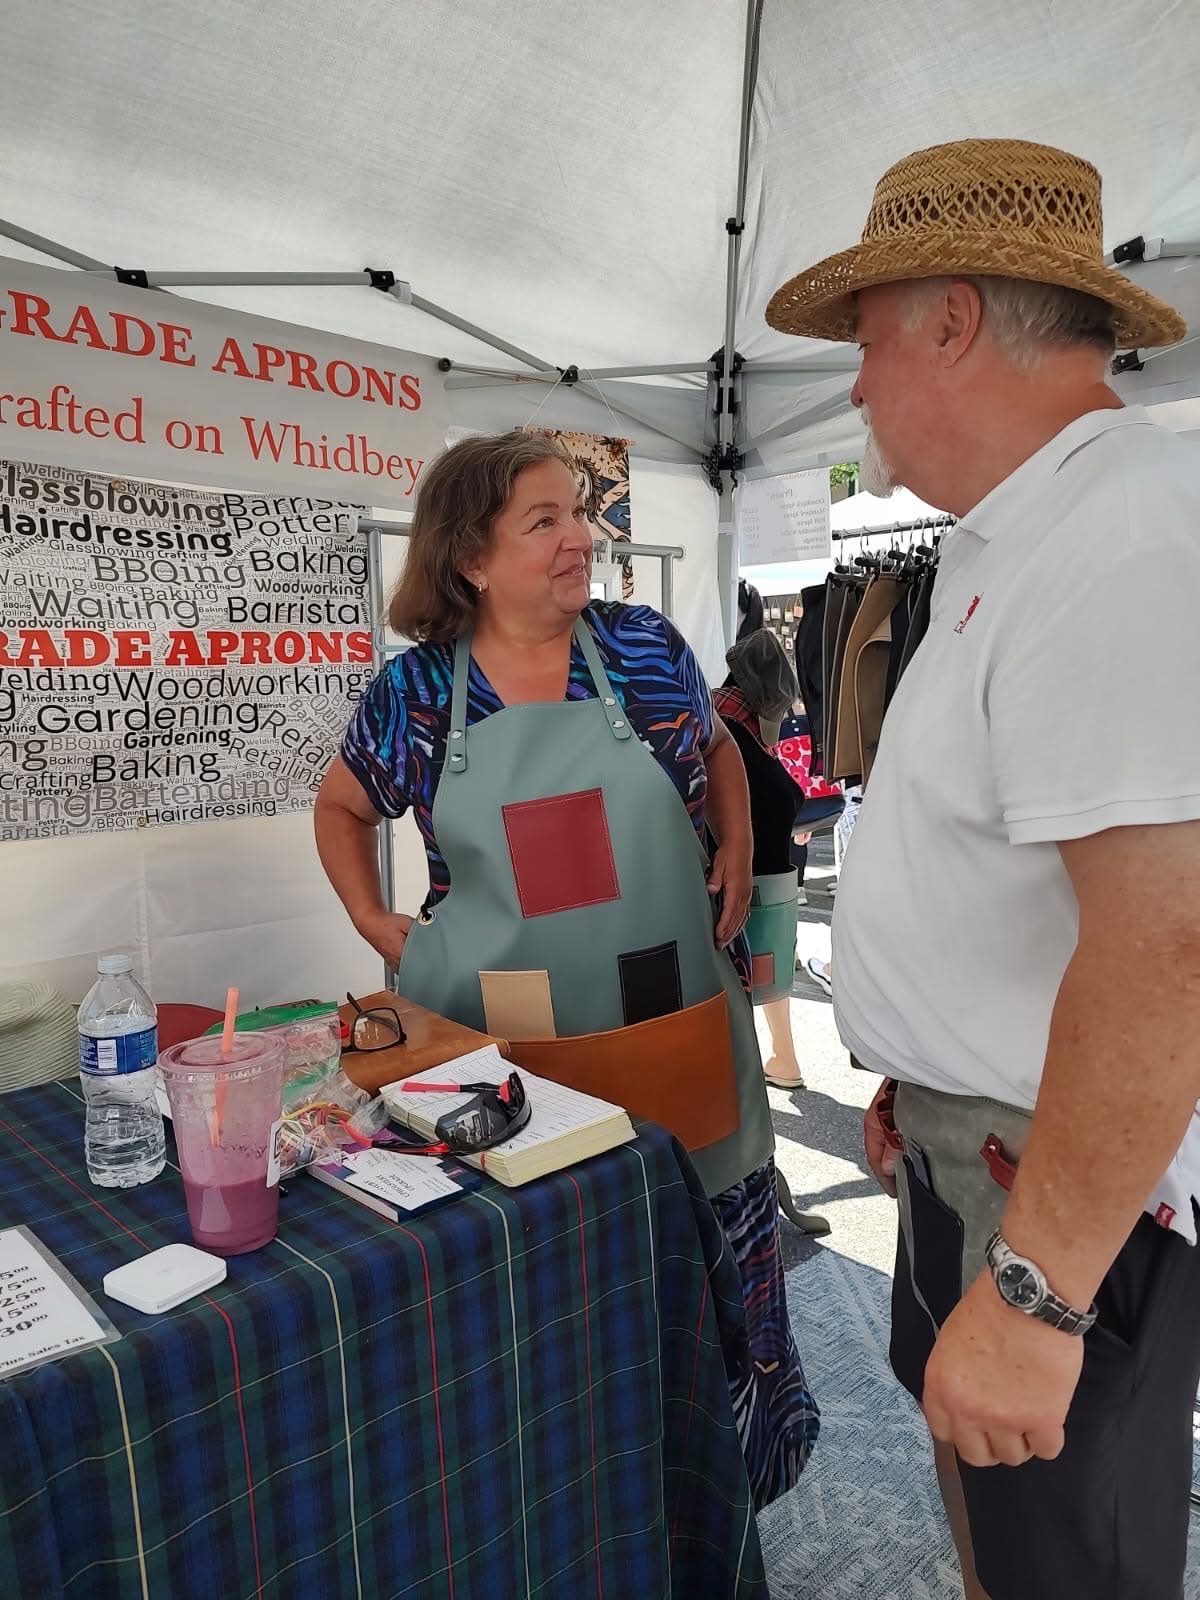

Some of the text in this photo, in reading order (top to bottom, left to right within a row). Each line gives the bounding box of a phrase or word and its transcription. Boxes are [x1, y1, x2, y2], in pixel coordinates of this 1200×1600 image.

[0, 290, 422, 411] RADE APRONS
[165, 420, 224, 454] on
[240, 416, 424, 496] Whidbey
[23, 463, 84, 485] Welding
[0, 465, 226, 527] lassblowing
[118, 481, 165, 501] Styling
[1, 533, 45, 558] Waiting
[49, 539, 154, 561] Glassblowing
[264, 533, 333, 550] Welding
[334, 543, 368, 556] Welding
[158, 550, 207, 561] Crafting
[250, 545, 368, 585] Baking
[91, 554, 246, 589] BBQing
[90, 581, 135, 593] BBQing
[140, 585, 218, 603] Baking
[194, 583, 231, 591] Crafting
[254, 578, 365, 600] Woodworking
[28, 588, 200, 628] Waiting
[199, 606, 229, 614] Baking
[227, 596, 360, 625] Barrista
[107, 620, 157, 631] Baking
[165, 631, 373, 666] APRONS
[155, 668, 209, 678] Retailing
[318, 664, 363, 674] Barrista
[0, 668, 110, 696] elding
[112, 667, 364, 701] Woodworking
[22, 694, 95, 704] Hairdressing
[37, 700, 259, 734] Gardening
[289, 699, 335, 752] Barrista
[50, 737, 122, 751] BBQing
[123, 728, 232, 749] Gardening
[49, 755, 93, 767] Baking
[270, 748, 298, 757] Styling
[92, 750, 221, 783] Baking
[228, 737, 327, 792] Retailing
[0, 770, 92, 791] Crafting
[166, 776, 200, 786] Waiting
[29, 788, 73, 798] Pottery
[93, 774, 291, 812] Bartending
[105, 809, 145, 818] Gardening
[145, 799, 276, 824] Hairdressing
[38, 818, 65, 827] Pottery
[28, 1344, 61, 1356] Sales
[64, 1336, 85, 1345] Tax
